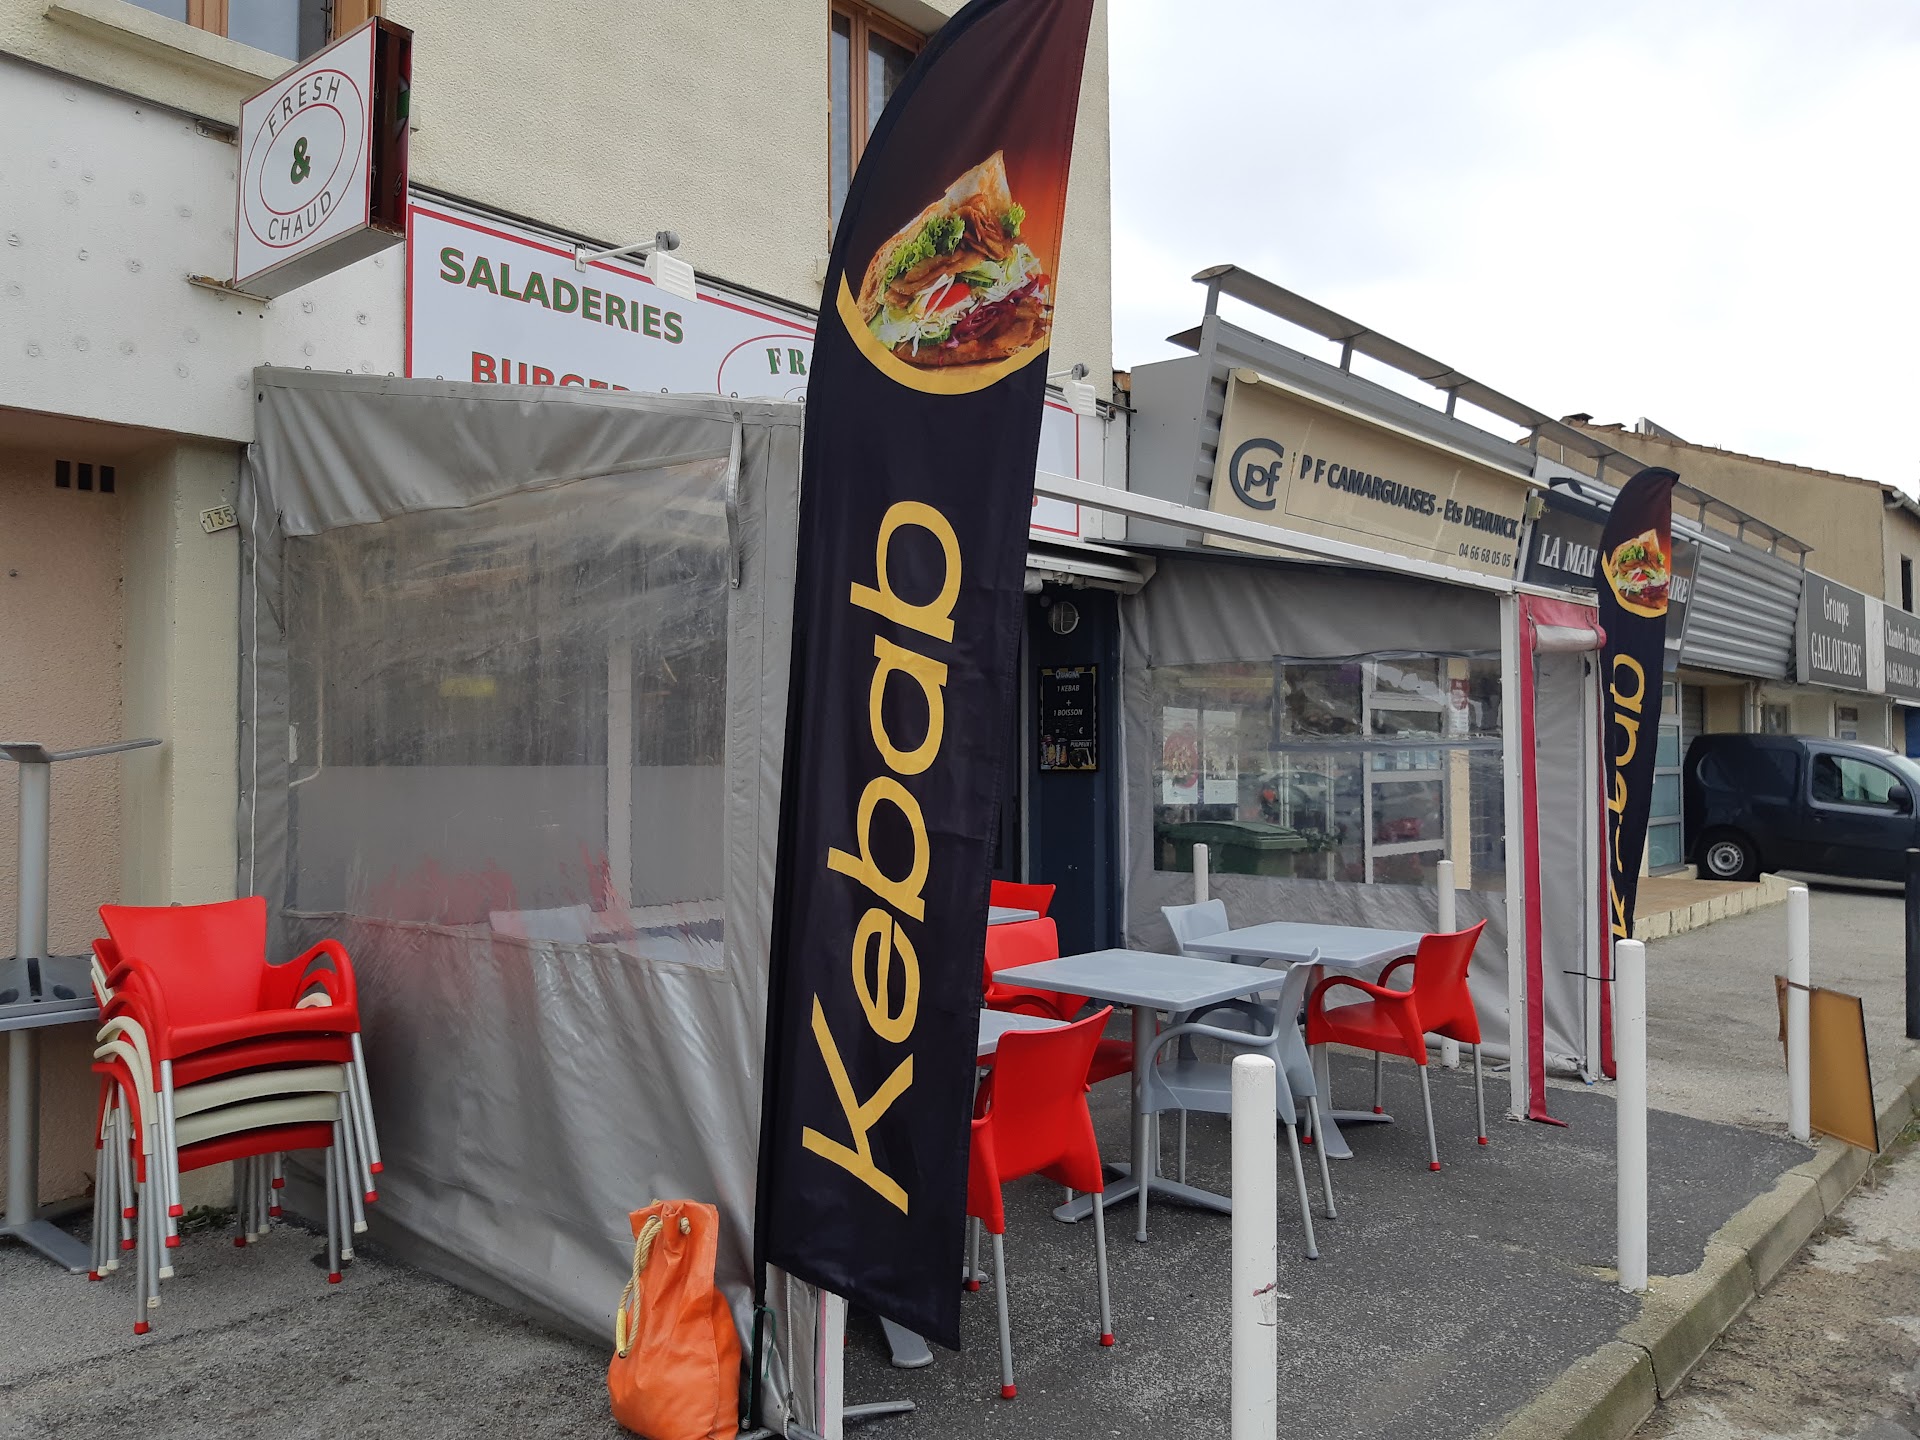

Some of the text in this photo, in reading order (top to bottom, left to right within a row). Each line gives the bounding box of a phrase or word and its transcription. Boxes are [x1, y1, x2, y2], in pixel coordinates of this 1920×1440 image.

[268, 76, 341, 137] FRESH
[290, 136, 311, 185] &
[268, 190, 332, 241] CHAUD
[439, 247, 685, 344] SALADERIES
[207, 509, 233, 527] 135
[1300, 455, 1313, 480] P
[1313, 459, 1327, 483] F
[1327, 463, 1437, 516] CAMARGUAISES
[1443, 499, 1464, 524] Ets
[1464, 505, 1520, 540] DEMUNCK
[1459, 543, 1512, 568] 04 66 68 05 05
[1537, 534, 1561, 569] LA
[1562, 541, 1598, 578] MAI
[1823, 585, 1849, 633] Groupe
[1811, 632, 1862, 677] GALLOUEDEC
[1885, 619, 1906, 651] Chambre
[1061, 684, 1080, 692] KEBAB
[1057, 708, 1083, 716] BOISSON
[801, 500, 963, 1216] Kebab
